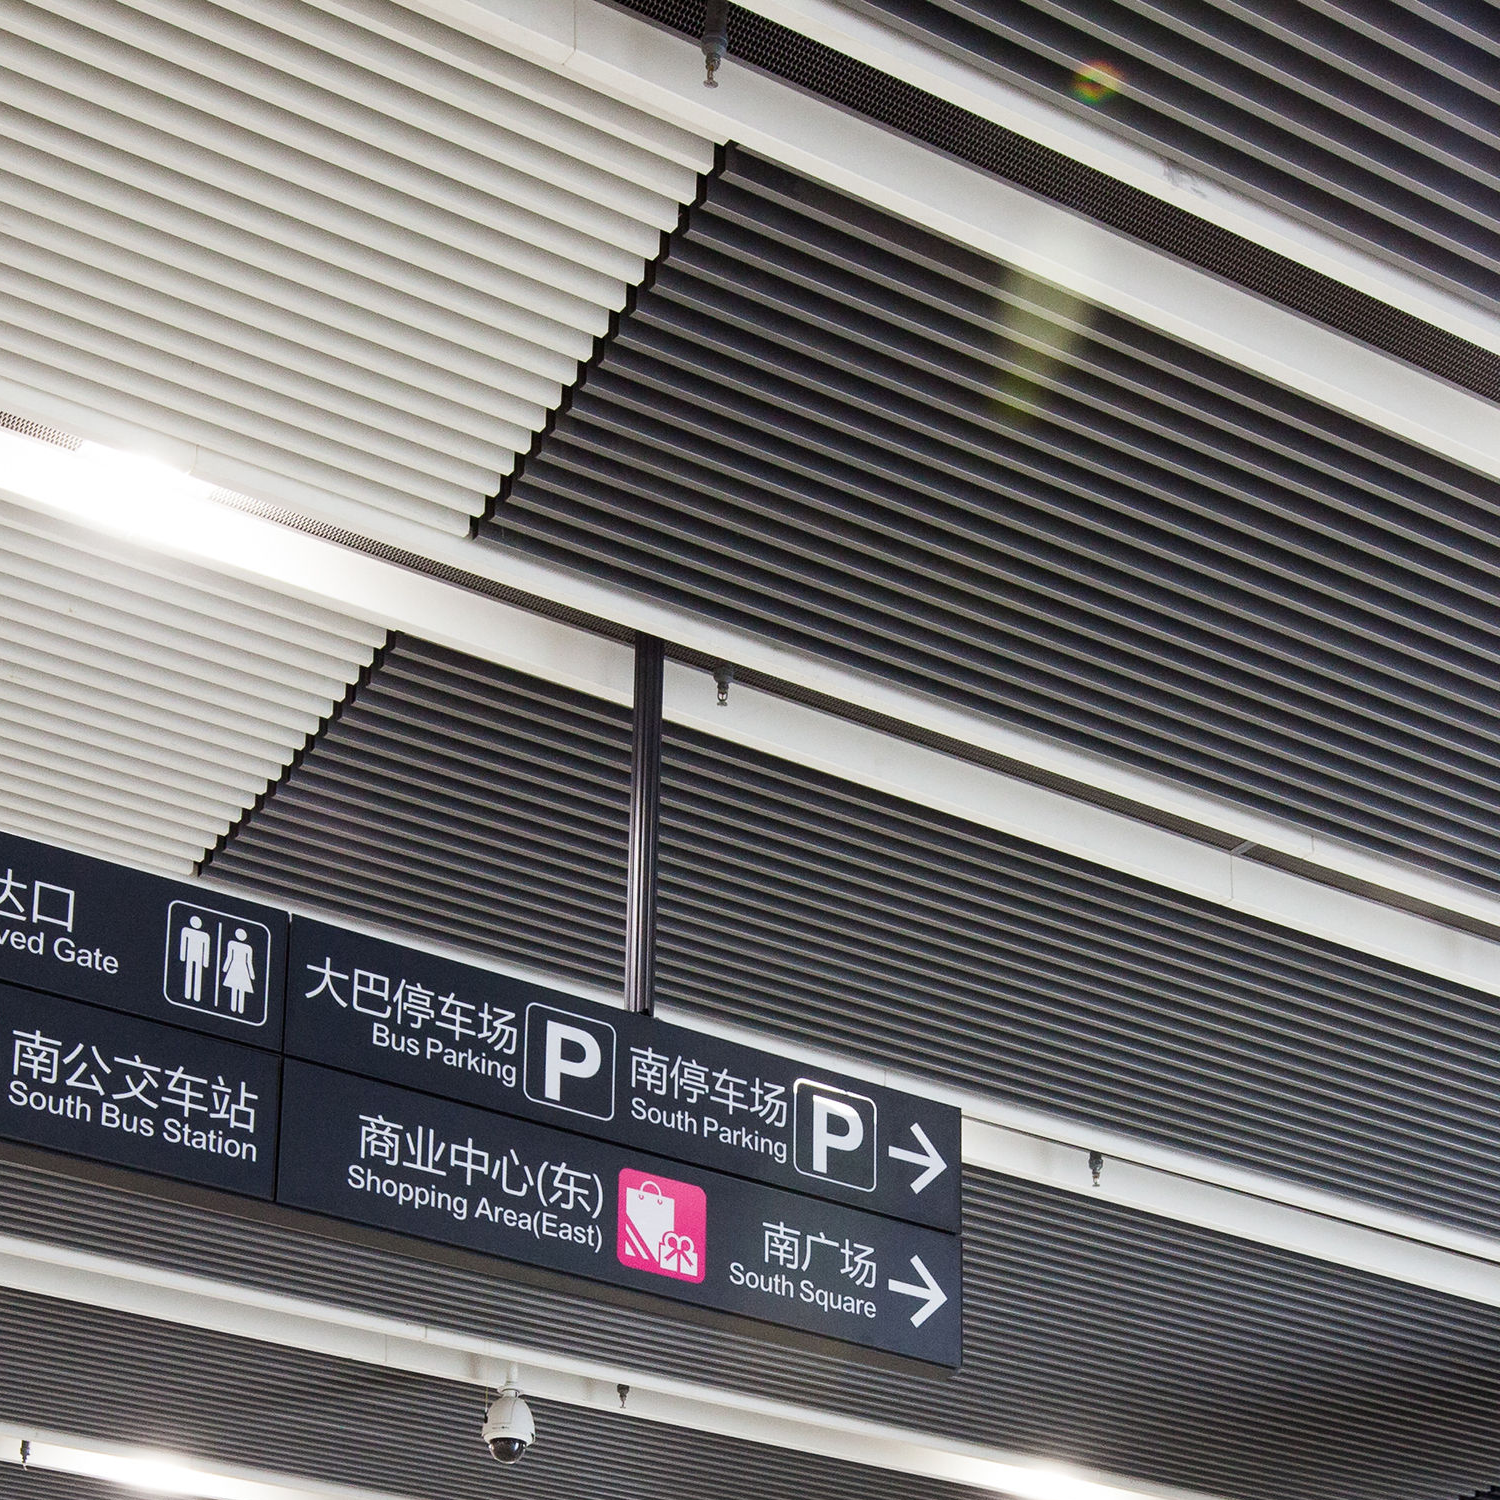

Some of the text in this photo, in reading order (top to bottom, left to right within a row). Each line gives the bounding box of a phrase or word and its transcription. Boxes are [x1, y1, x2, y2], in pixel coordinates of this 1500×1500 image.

[53, 936, 120, 975] Gate
[304, 955, 518, 1056] 大巴停车场
[11, 1028, 259, 1134] 南公交车站
[371, 1023, 517, 1089] Bus Parking
[544, 1019, 602, 1103] P
[629, 1046, 788, 1130] 南停车场
[8, 1081, 258, 1164] South Bus Station
[630, 1096, 787, 1165] South Parking
[811, 1093, 865, 1175] P
[358, 1113, 605, 1220] 商业中心(东)
[347, 1164, 604, 1253] Shopping Area(East)
[728, 1262, 878, 1320] South Square
[762, 1220, 878, 1290] 南广场
